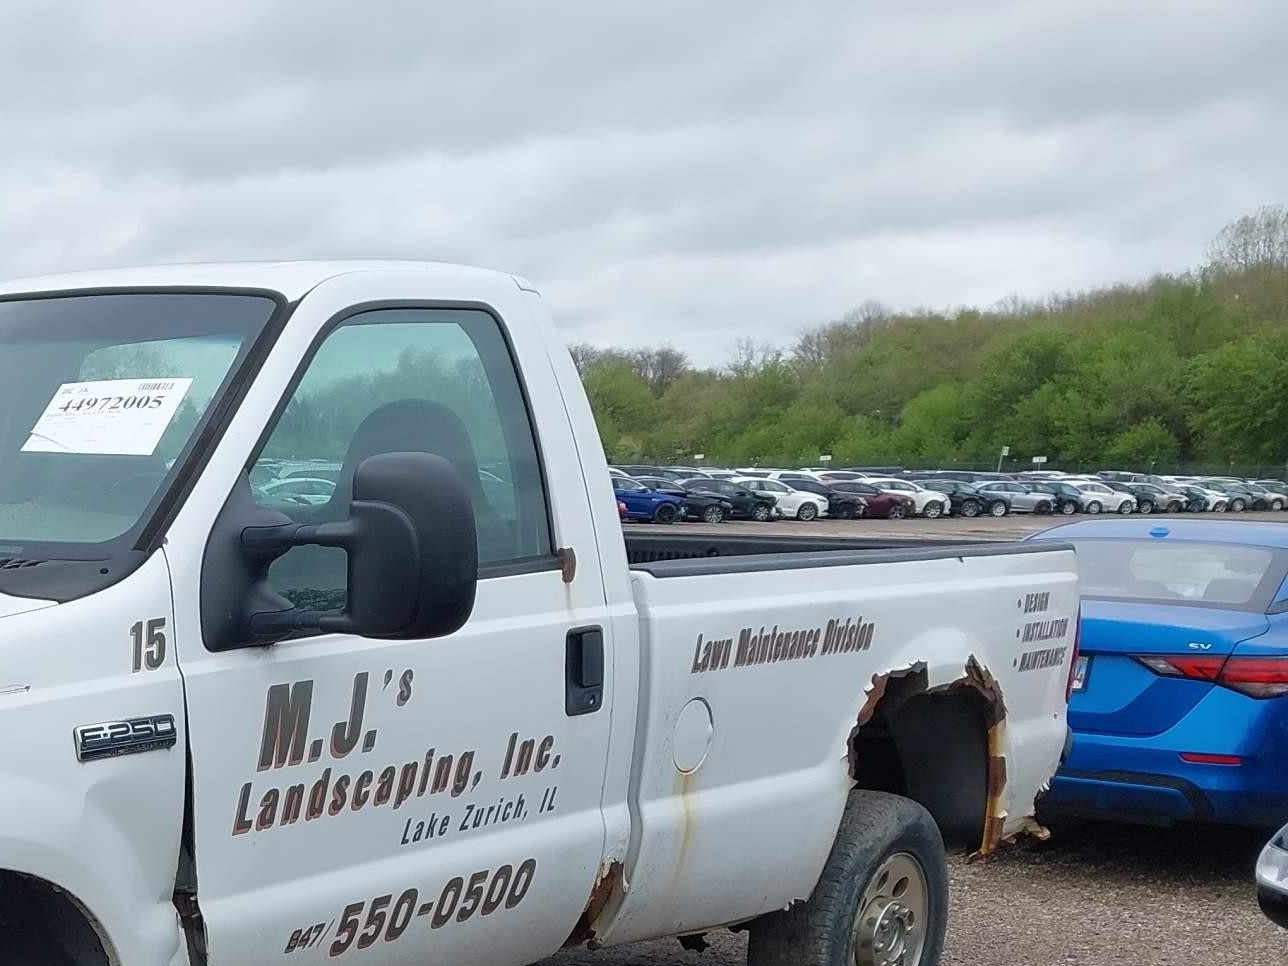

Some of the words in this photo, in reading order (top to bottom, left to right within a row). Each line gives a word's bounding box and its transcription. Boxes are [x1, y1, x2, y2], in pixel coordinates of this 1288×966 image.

[59, 395, 166, 412] 44972005
[1024, 592, 1050, 614] DESIGN
[130, 617, 167, 673] 15
[691, 633, 733, 674] Lawn
[734, 625, 821, 667] Maintenance
[820, 616, 875, 656] Division
[1022, 618, 1069, 643] INSTALLATION
[1188, 642, 1212, 650] SV
[1018, 646, 1068, 672] MAINTENANCE
[256, 668, 414, 773] M.J.'s
[232, 748, 483, 836] Landscaping,
[500, 732, 562, 780] Inc.
[400, 813, 450, 845] Lake
[459, 793, 528, 831] Zurich,
[539, 786, 558, 814] IL
